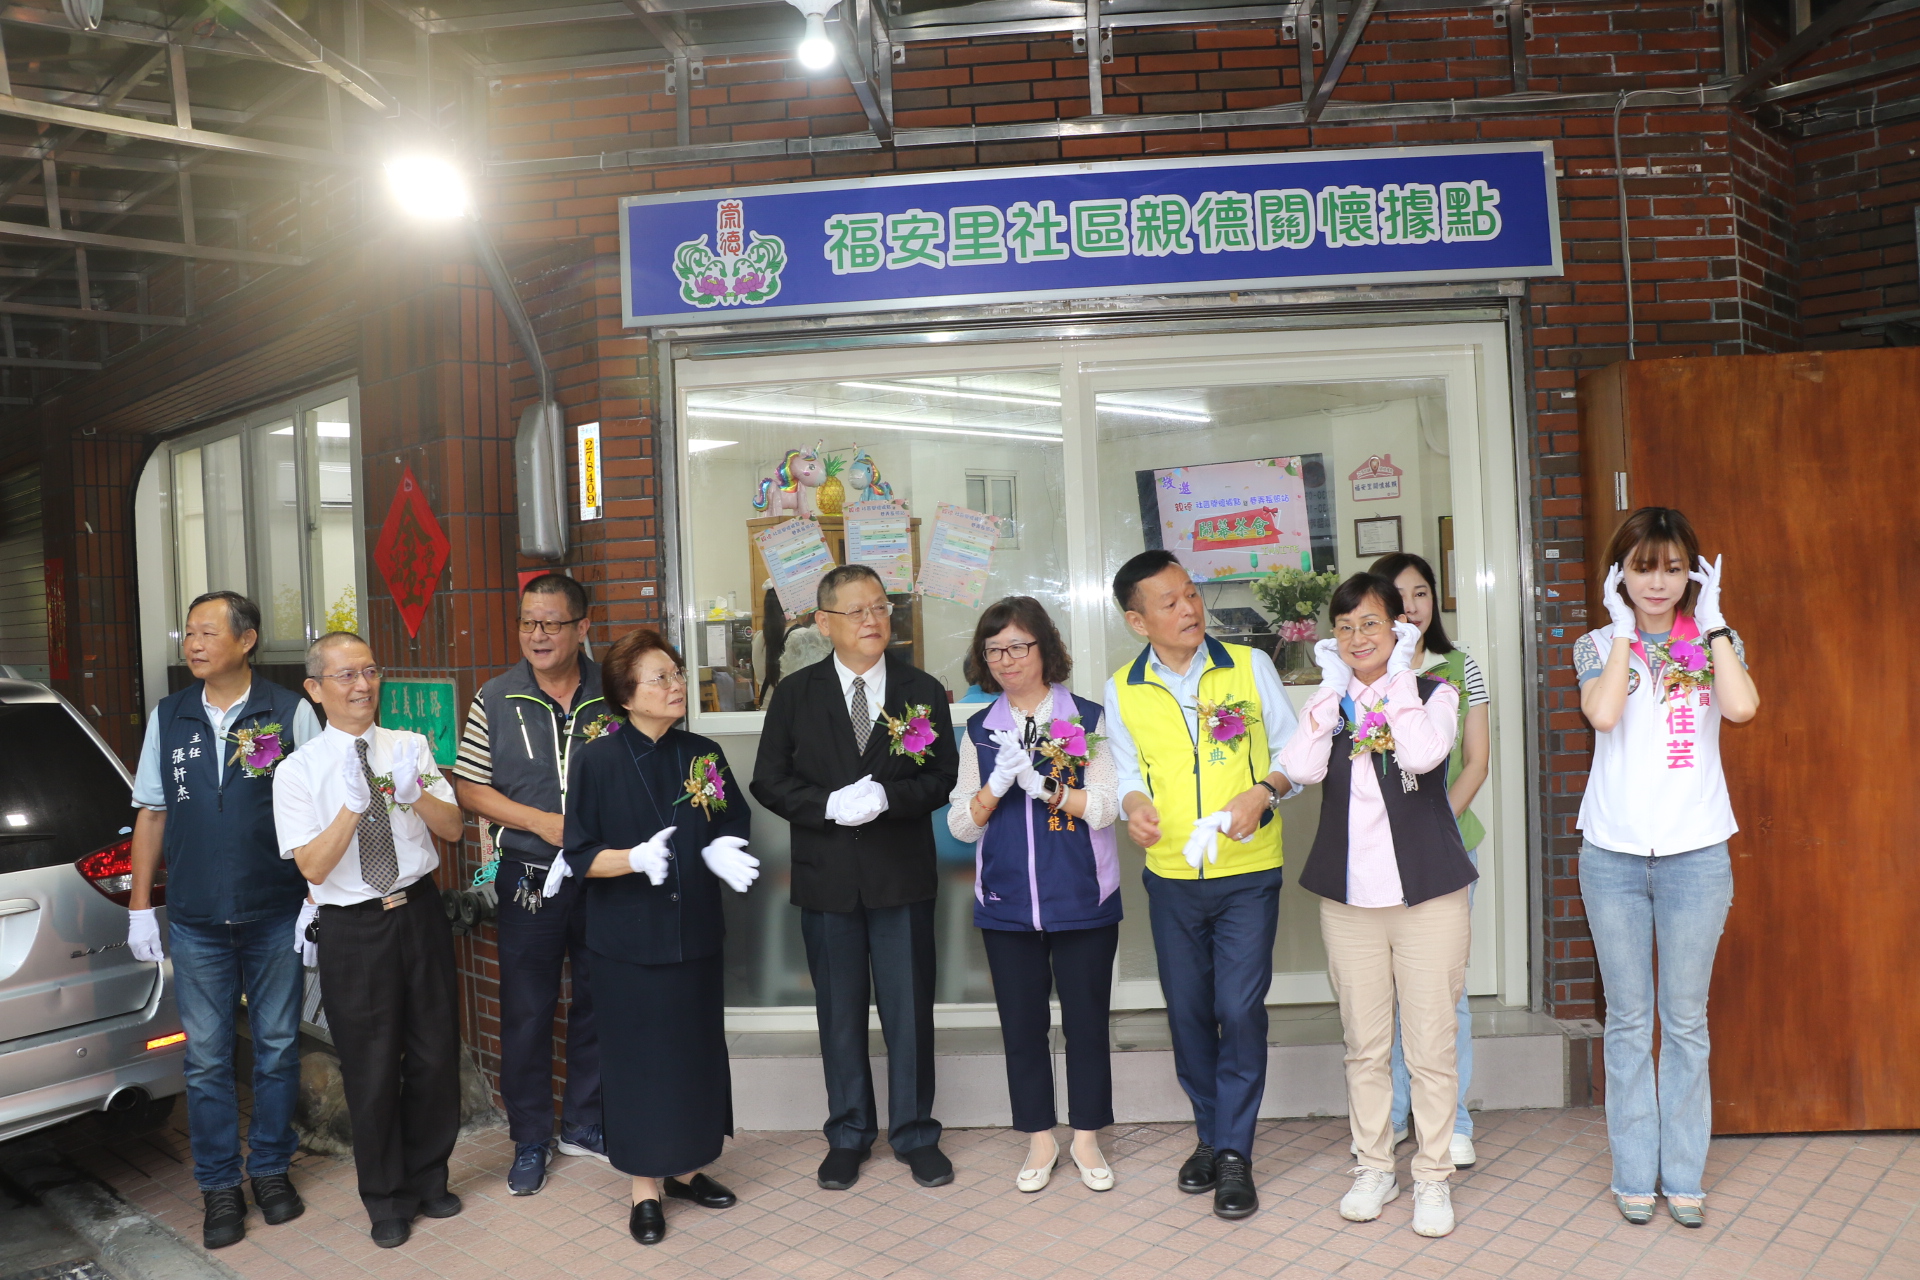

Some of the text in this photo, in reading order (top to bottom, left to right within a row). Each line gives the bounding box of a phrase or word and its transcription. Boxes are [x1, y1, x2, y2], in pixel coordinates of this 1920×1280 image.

[720, 203, 741, 256] 崇德
[827, 184, 1499, 271] 福安里社區親德關懷據點
[585, 440, 595, 505] 278409
[1161, 476, 1192, 495] 敬邀
[1198, 516, 1270, 539] 開幕茶會
[391, 686, 442, 720] 正義北路
[188, 732, 202, 759] 主任
[171, 747, 190, 803] 張軒杰
